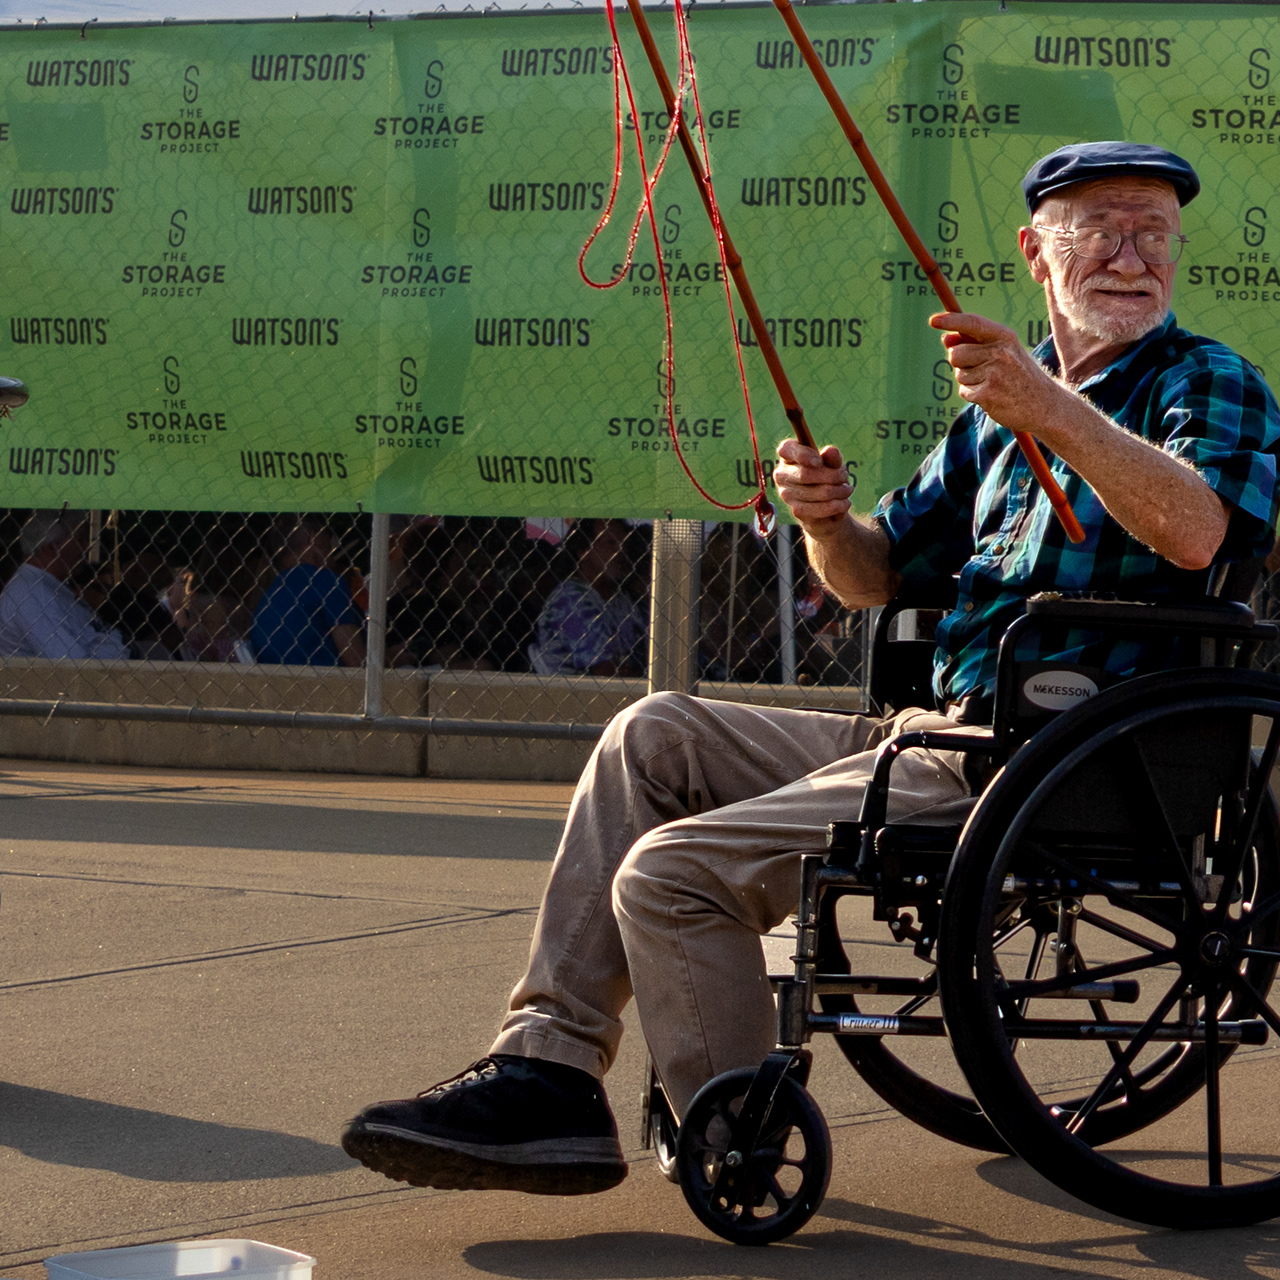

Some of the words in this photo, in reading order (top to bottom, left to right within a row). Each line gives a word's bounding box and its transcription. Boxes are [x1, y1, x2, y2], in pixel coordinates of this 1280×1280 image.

[1035, 36, 1170, 67] WATSON'S
[252, 54, 365, 81] WATSON'S
[502, 47, 613, 76] WATSON'S
[27, 60, 130, 86] WATSON'S
[936, 90, 967, 100] THE
[1243, 96, 1275, 105] THE
[180, 109, 202, 118] THE
[418, 104, 444, 113] THE
[887, 104, 1020, 124] STORAGE
[141, 120, 240, 140] STORAGE
[374, 116, 484, 135] STORAGE
[912, 128, 990, 138] PROJECT
[161, 143, 219, 153] PROJECT
[395, 138, 458, 148] PROJECT
[11, 187, 114, 214] WATSON'S
[248, 186, 352, 214] WATSON'S
[489, 183, 604, 211] WATSON'S
[742, 177, 865, 206] WATSON'S
[163, 252, 186, 262] THE
[408, 253, 432, 262] THE
[661, 249, 682, 259] HE
[931, 248, 964, 258] THE
[1237, 253, 1269, 263] THE
[122, 265, 225, 283] STORAGE
[362, 265, 472, 284] STORAGE
[610, 263, 725, 282] STORAGE
[142, 287, 202, 297] PROJECT
[382, 287, 446, 297] PROJECT
[906, 286, 985, 296] PROECT
[11, 318, 106, 345] WATSON'S
[233, 318, 338, 345] WATSON'S
[475, 318, 589, 346] WATSON'S
[163, 400, 186, 409] THE
[396, 402, 422, 412] THE
[926, 406, 958, 417] THE
[127, 412, 226, 430] STORAGE
[356, 415, 464, 434] STORAGE
[608, 418, 725, 438] STORAGE
[877, 420, 947, 440] STOR
[149, 434, 206, 443] PROJECT
[379, 438, 440, 448] PROJECT
[9, 448, 115, 475] WATSON'S
[241, 451, 347, 479] WATSON'S
[477, 456, 592, 484] WATSON'S
